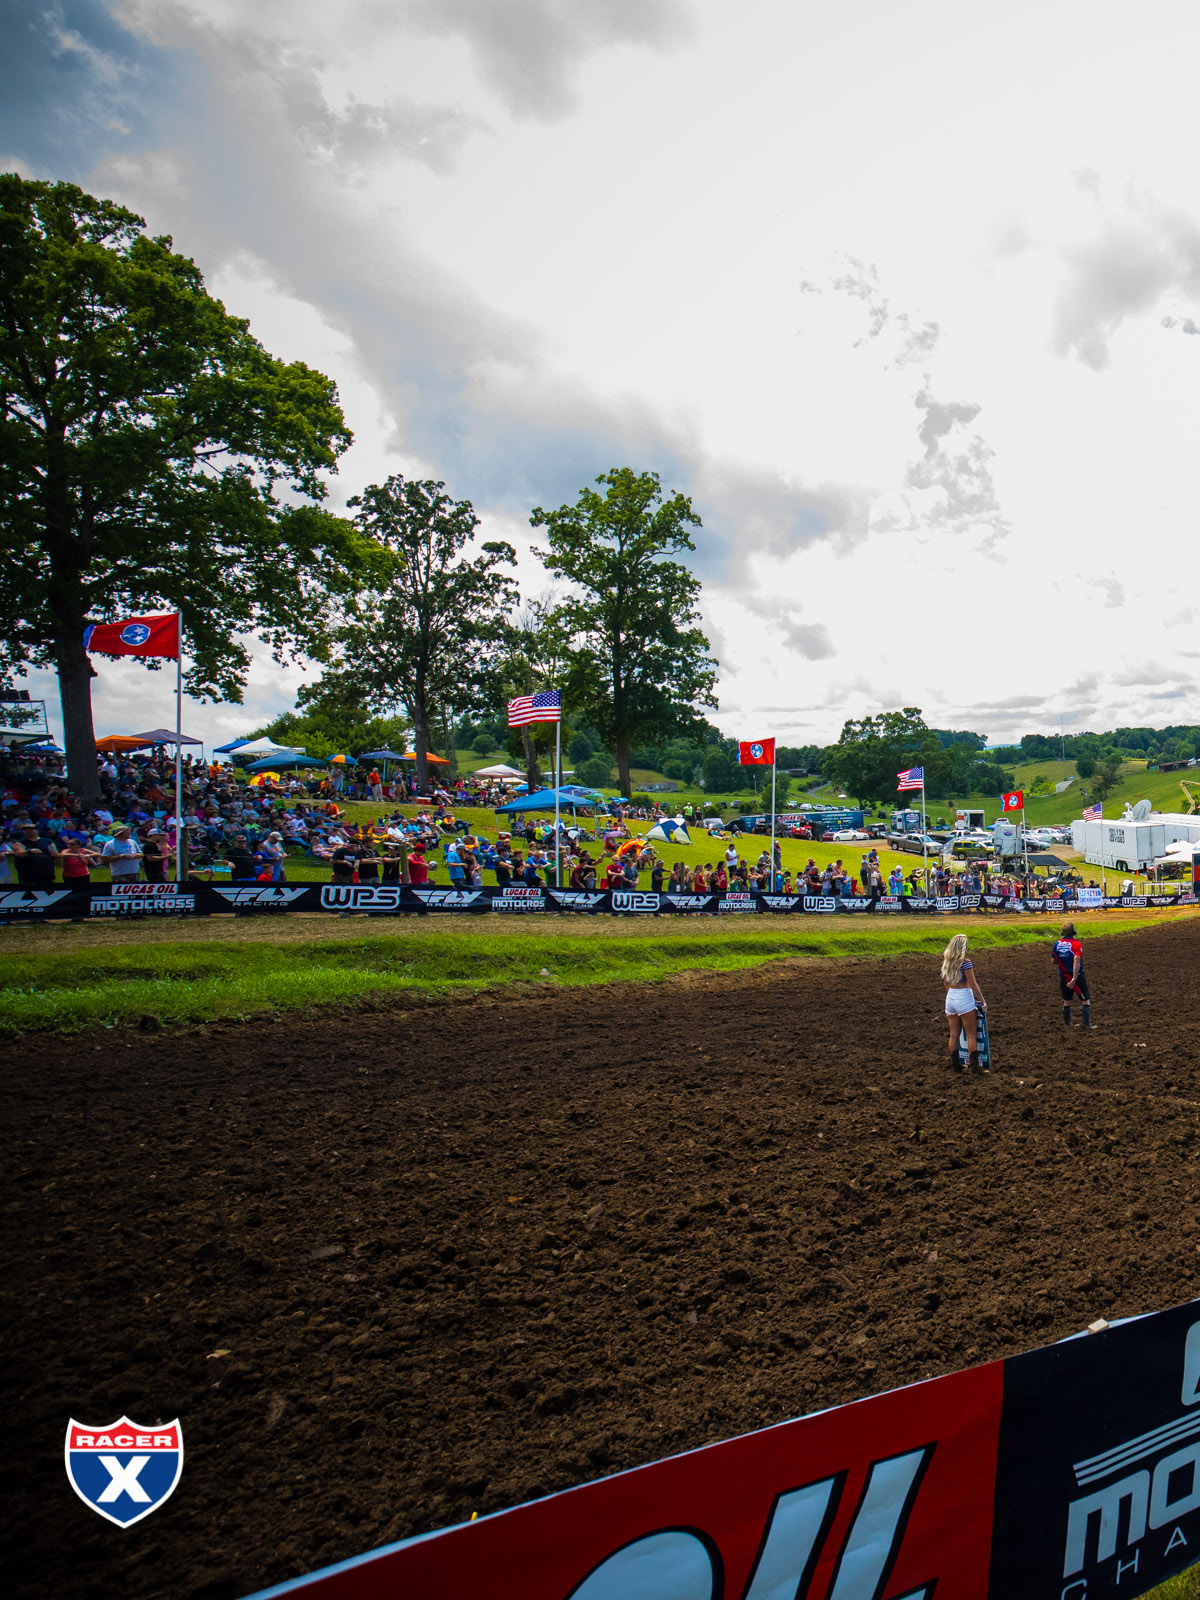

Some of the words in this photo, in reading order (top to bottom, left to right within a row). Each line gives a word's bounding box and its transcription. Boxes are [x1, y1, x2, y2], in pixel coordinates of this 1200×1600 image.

[115, 884, 155, 894] LUCAS
[156, 884, 175, 893] OIL
[212, 887, 310, 902] FLY
[0, 890, 72, 907] LY
[321, 885, 400, 910] WPS
[411, 890, 482, 903] FLY
[549, 892, 606, 904] FLY
[611, 892, 660, 911] WPS
[666, 896, 713, 905] FLY
[762, 896, 799, 905] FLY
[1122, 897, 1147, 907] WPS
[90, 899, 195, 911] MOTOCROSS
[804, 896, 835, 912] WPS
[840, 899, 873, 907] FLY
[936, 897, 959, 910] WPS
[1046, 899, 1064, 910] WPS
